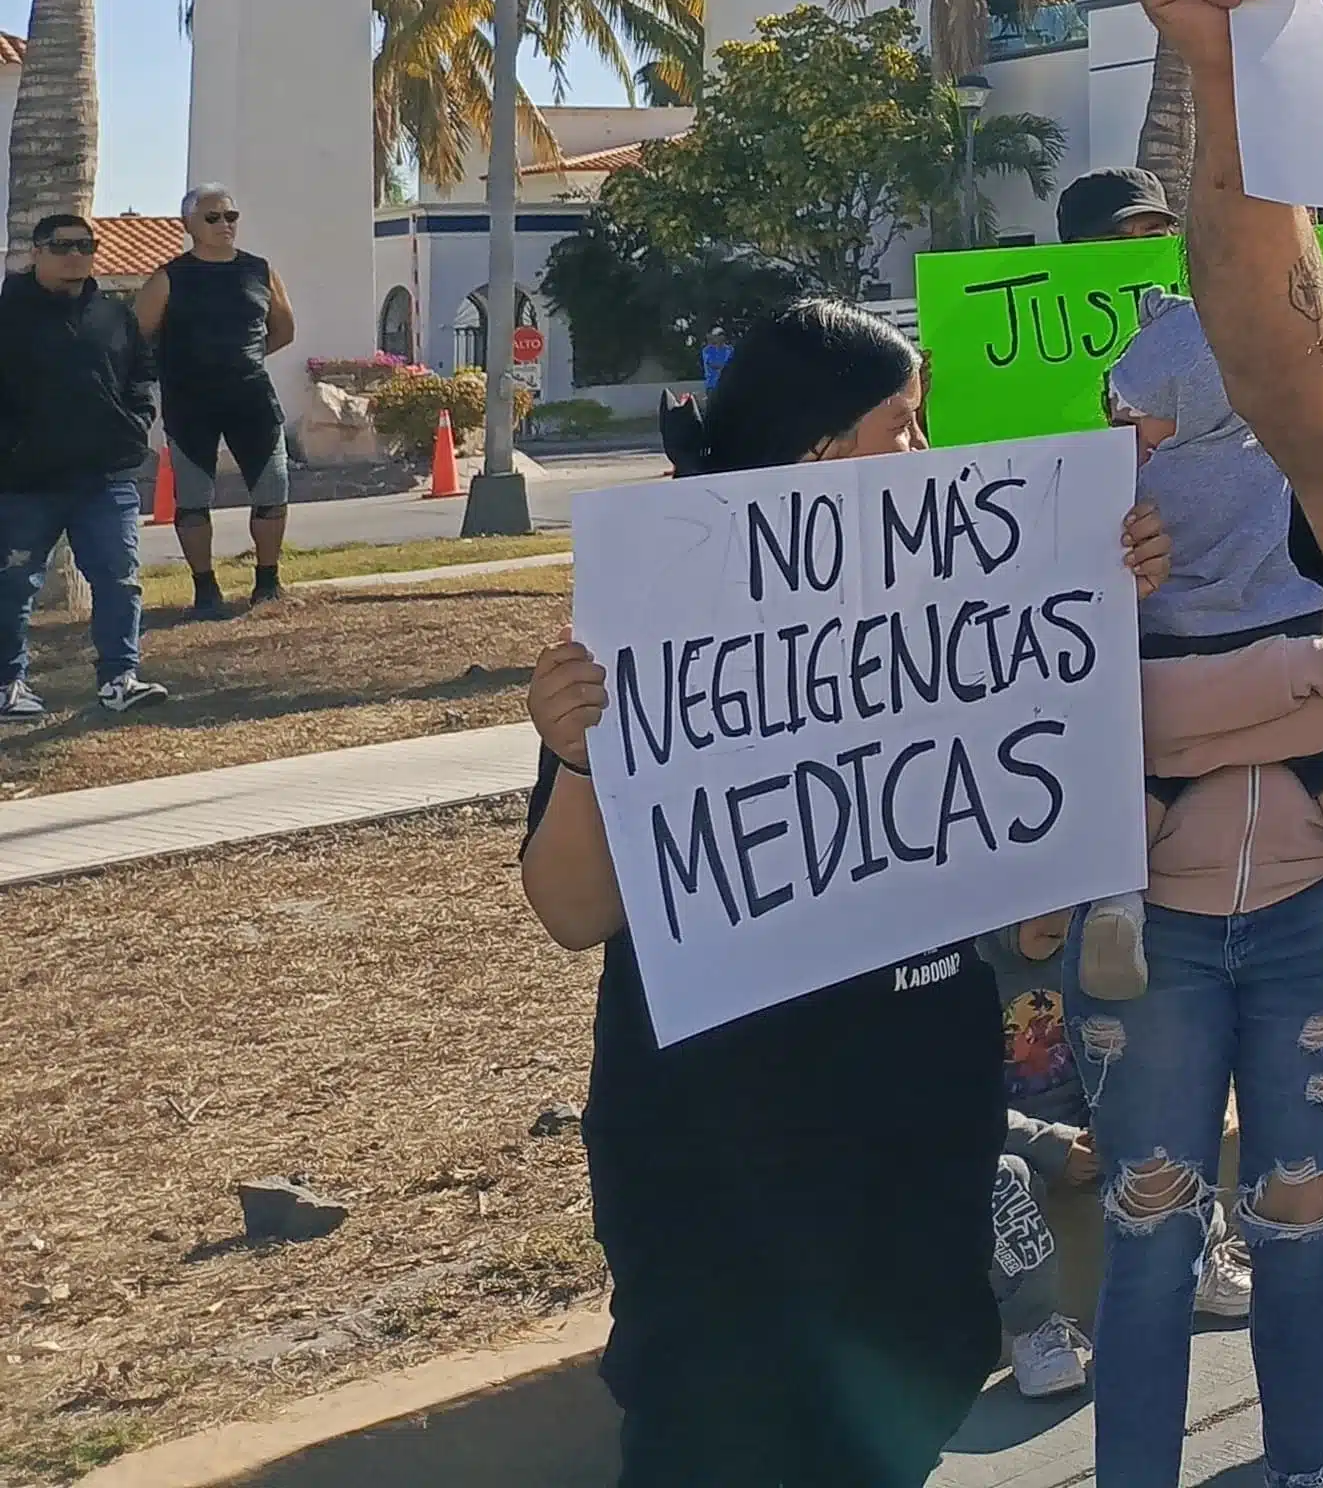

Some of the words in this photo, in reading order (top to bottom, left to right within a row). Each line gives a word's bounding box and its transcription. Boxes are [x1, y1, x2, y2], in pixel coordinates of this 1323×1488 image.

[965, 272, 1181, 366] JUST
[749, 492, 844, 601] NO
[883, 467, 1026, 589] MÁS
[616, 590, 1096, 776] NEGLIGENCIAS
[651, 719, 1066, 943] MEDICAS
